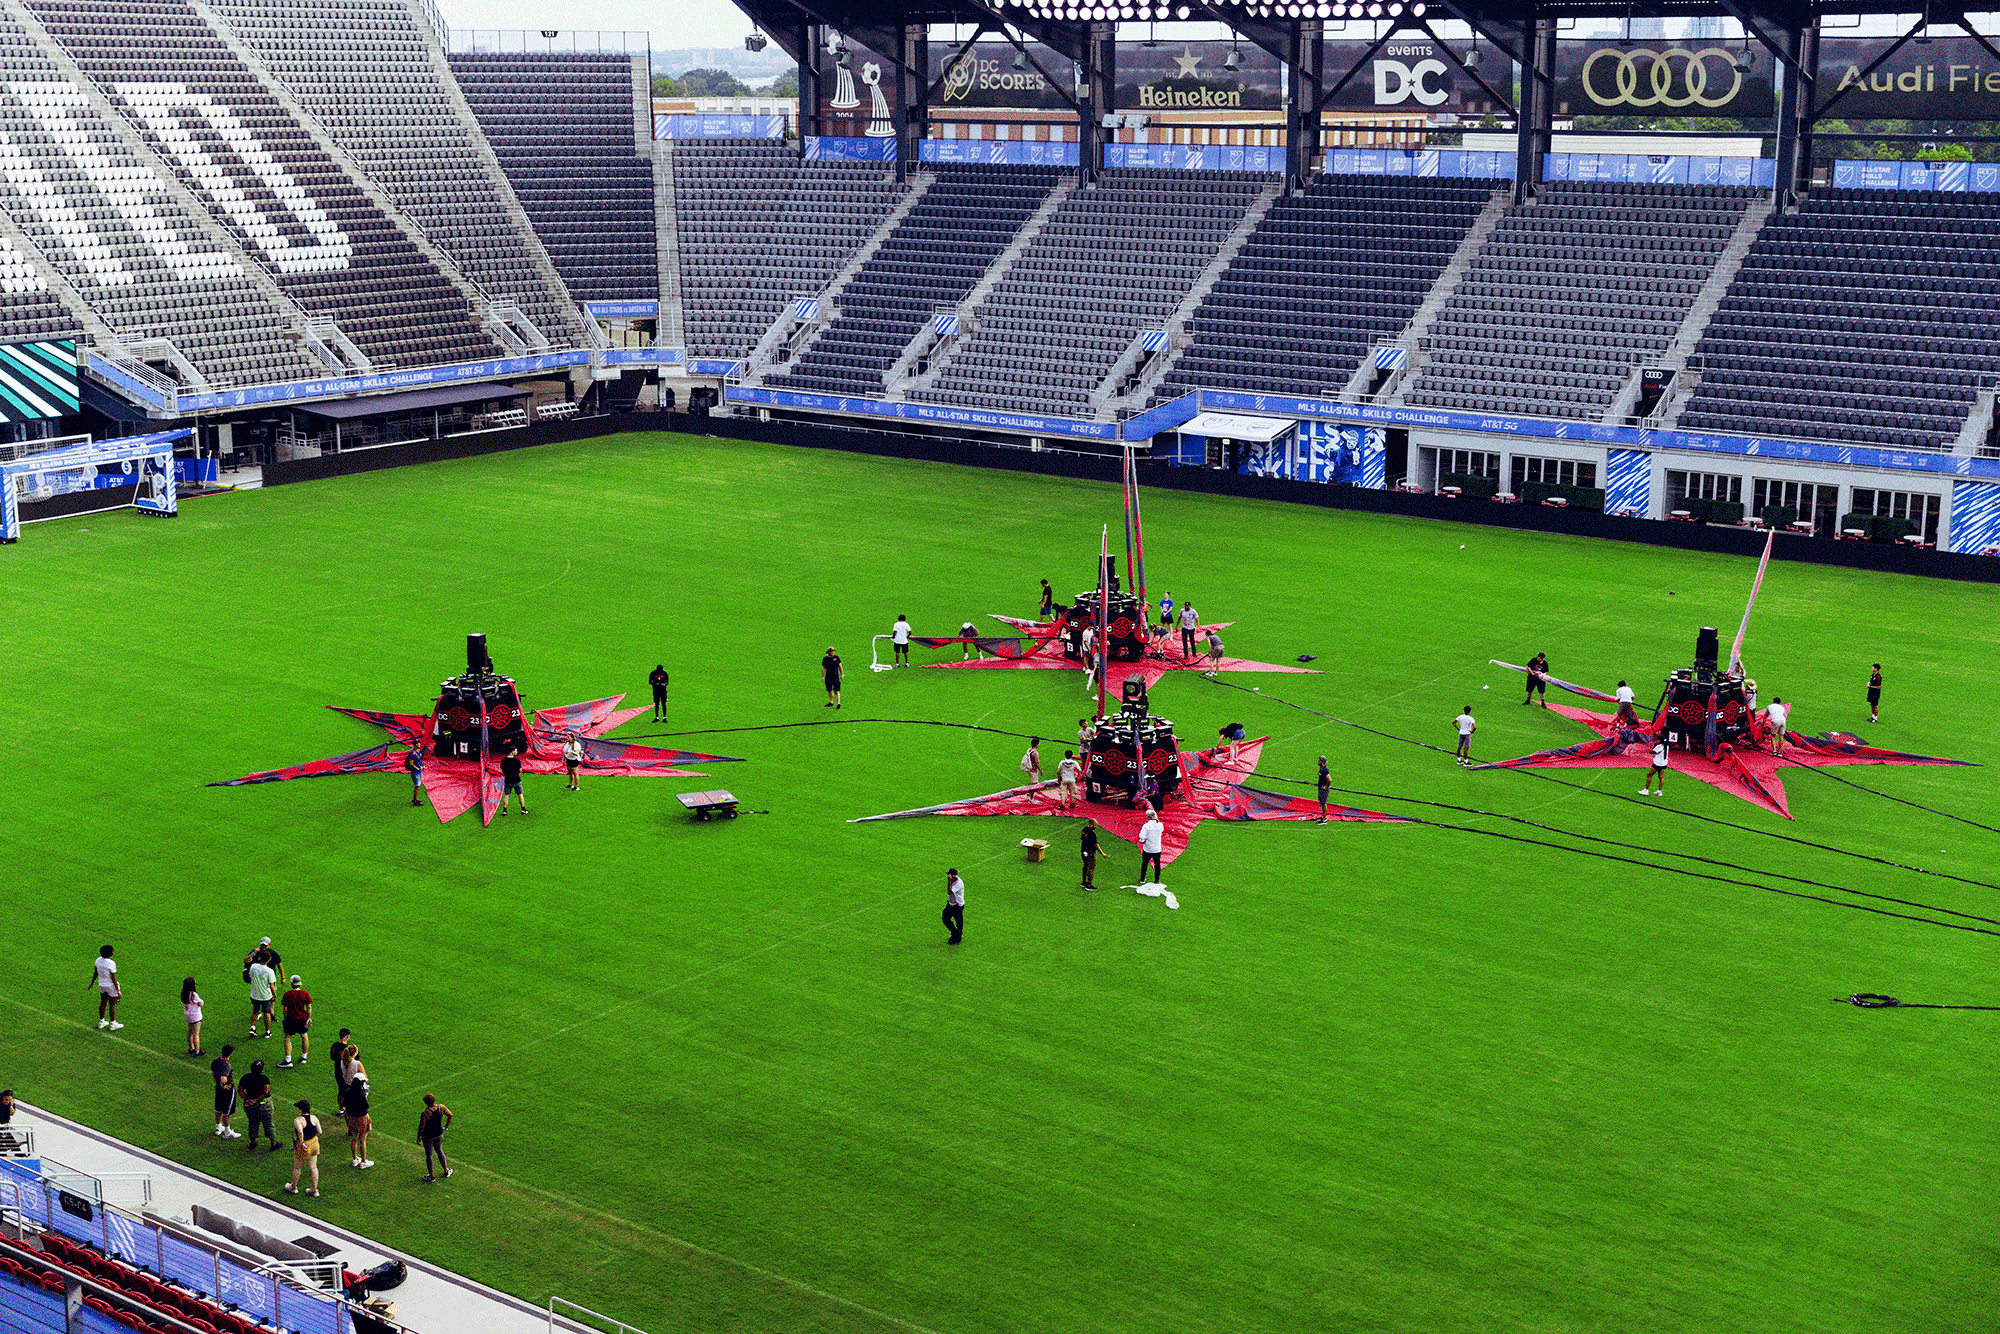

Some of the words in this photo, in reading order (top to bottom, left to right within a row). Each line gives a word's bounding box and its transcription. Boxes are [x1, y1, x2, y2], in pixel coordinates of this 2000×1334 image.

[1387, 46, 1432, 56] events
[980, 60, 999, 72] DC
[980, 73, 1045, 90] SCORES
[1373, 58, 1449, 106] DC
[1836, 65, 1934, 92] Audi
[1138, 86, 1241, 107] Heineken
[306, 384, 322, 393] MLS
[325, 381, 360, 391] ALL-STAR
[363, 377, 387, 388] SKILLS
[390, 372, 433, 384] CHALLENGE
[457, 368, 473, 376] AT&T
[473, 366, 484, 374] 5G
[918, 408, 934, 418] MLS
[936, 410, 970, 422] ALL-STAR
[972, 414, 997, 424] SKILLS
[999, 416, 1044, 429] CHALLENGE
[1070, 424, 1089, 433] AT&T
[1089, 426, 1102, 434] 5G
[1298, 402, 1316, 412] MLS
[1319, 405, 1359, 417] ALL-STAR
[1362, 409, 1392, 419] SKILLS
[1395, 412, 1449, 425] CHALLENGE
[1481, 419, 1503, 429] AT&T
[1503, 422, 1518, 430] 5G
[512, 709, 520, 718] 23
